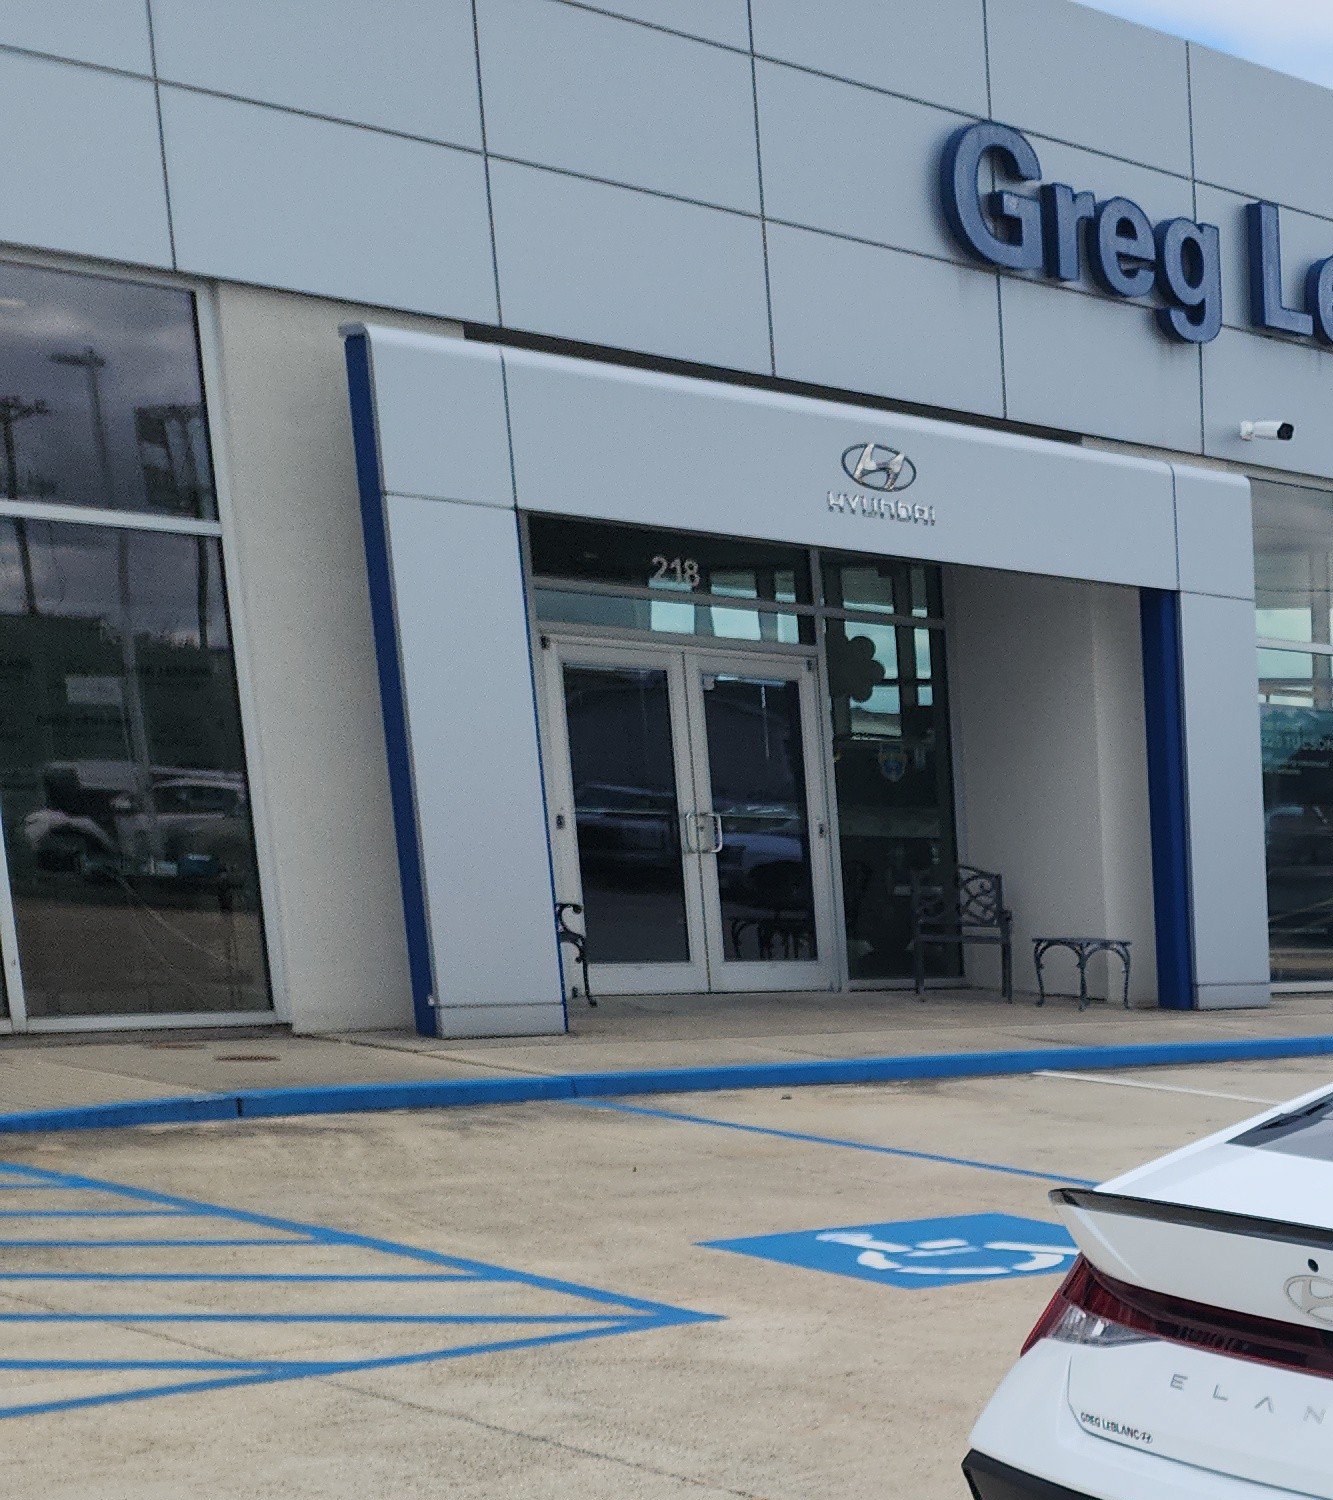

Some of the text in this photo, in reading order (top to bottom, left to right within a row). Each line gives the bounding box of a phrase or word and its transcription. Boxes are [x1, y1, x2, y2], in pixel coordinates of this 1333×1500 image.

[940, 121, 1222, 344] Greg
[827, 491, 936, 526] HYUNDAI
[651, 555, 700, 588] 218
